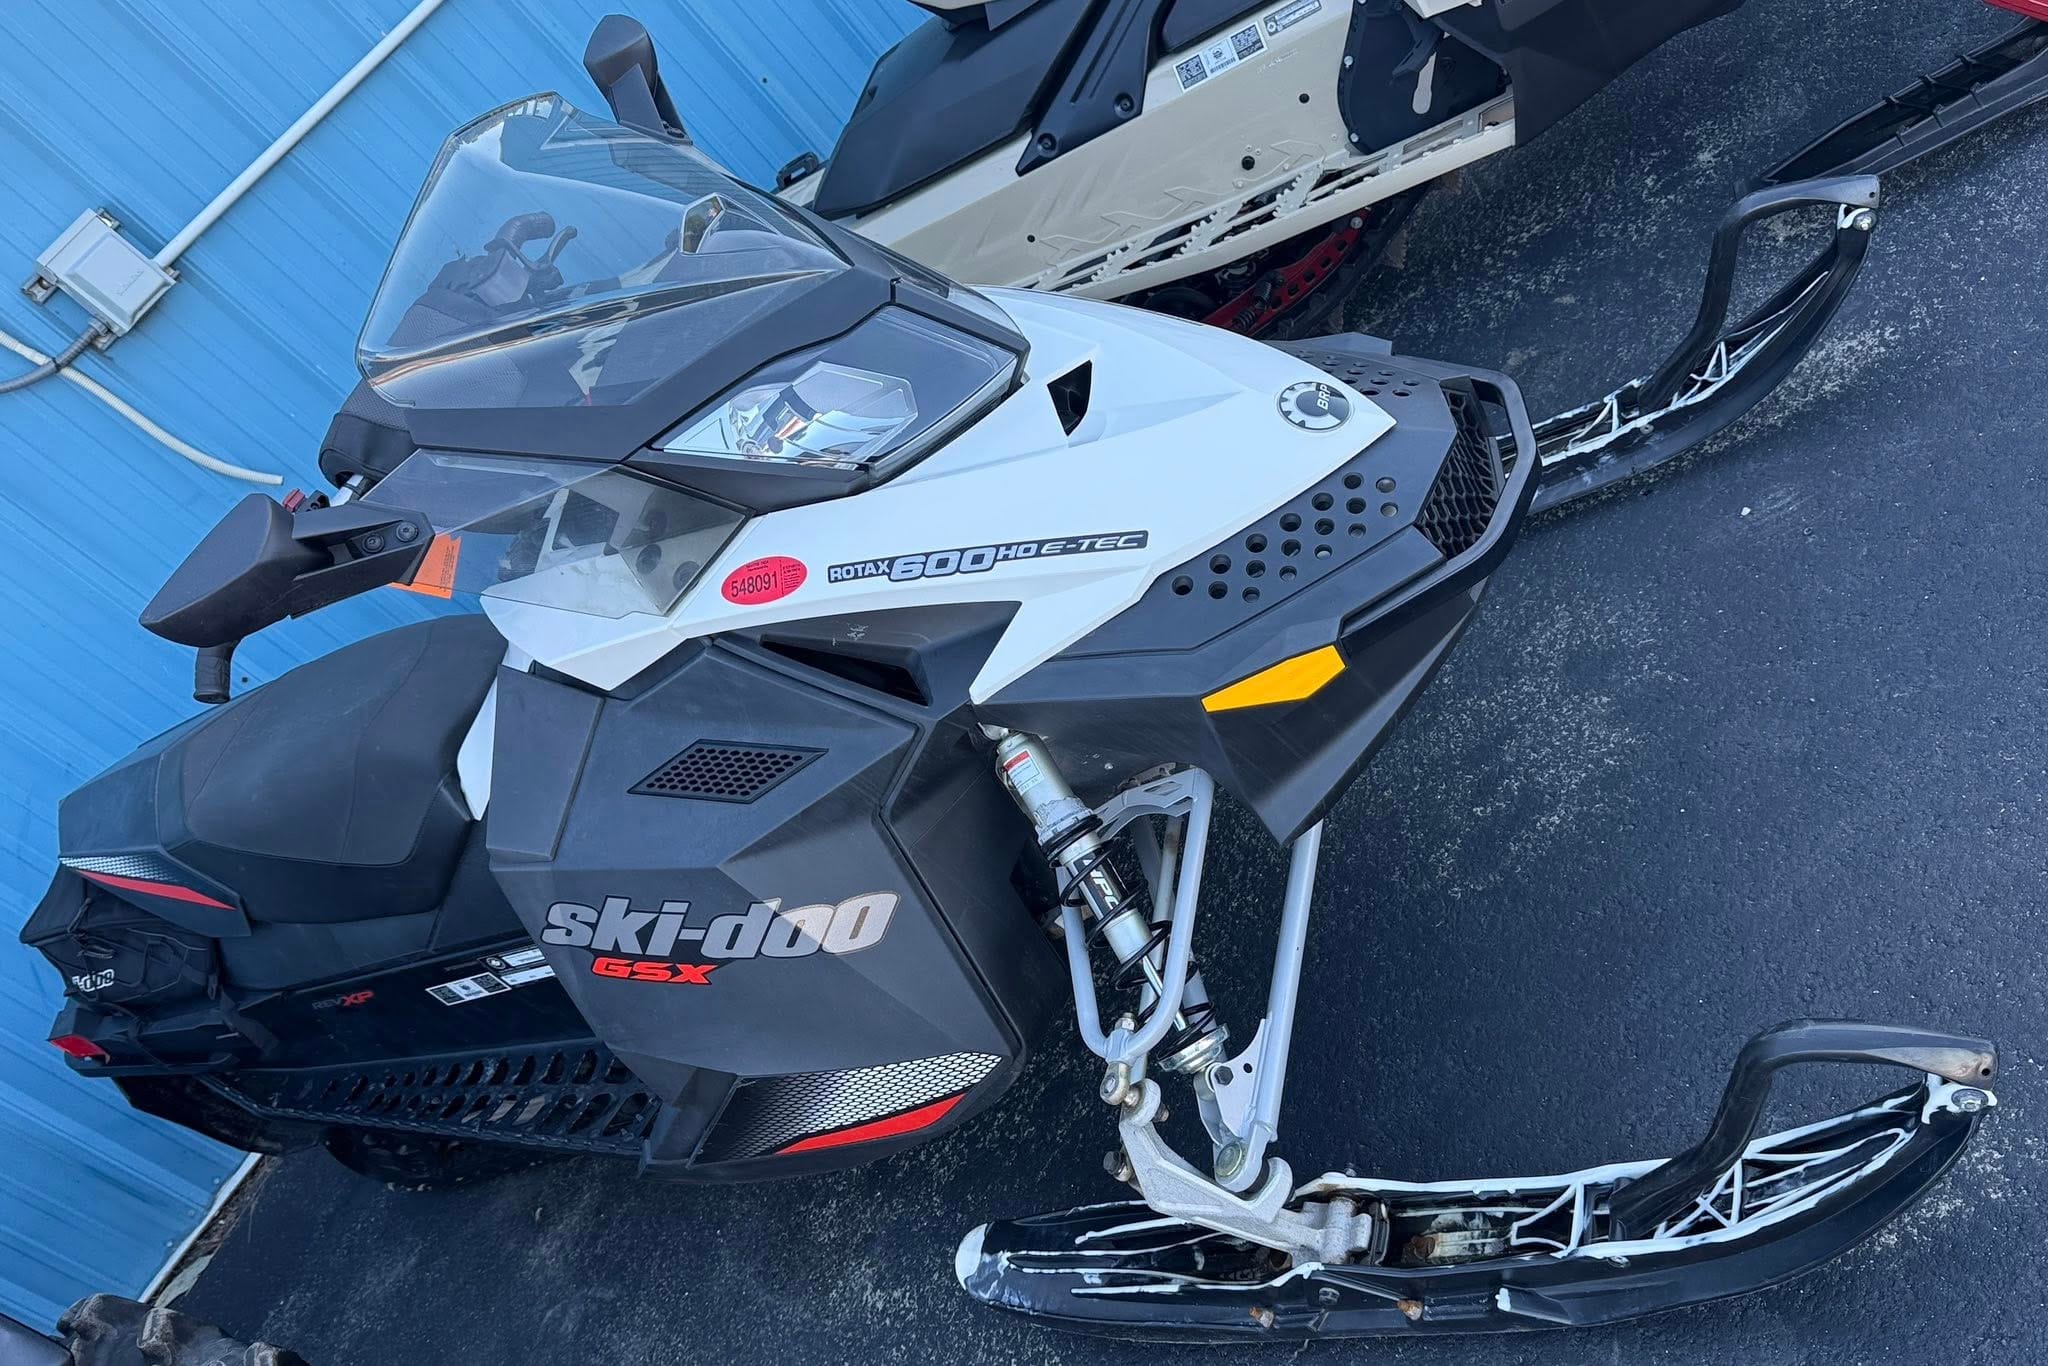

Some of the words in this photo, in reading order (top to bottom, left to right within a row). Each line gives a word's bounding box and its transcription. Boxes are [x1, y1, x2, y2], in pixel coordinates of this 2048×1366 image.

[1317, 384, 1331, 410] BRP
[829, 559, 891, 582] ROTAX
[890, 547, 997, 581] 600
[1040, 534, 1144, 555] E-TEC
[731, 570, 778, 598] 548091
[541, 891, 901, 960] ski-doo
[591, 956, 719, 985] GSX
